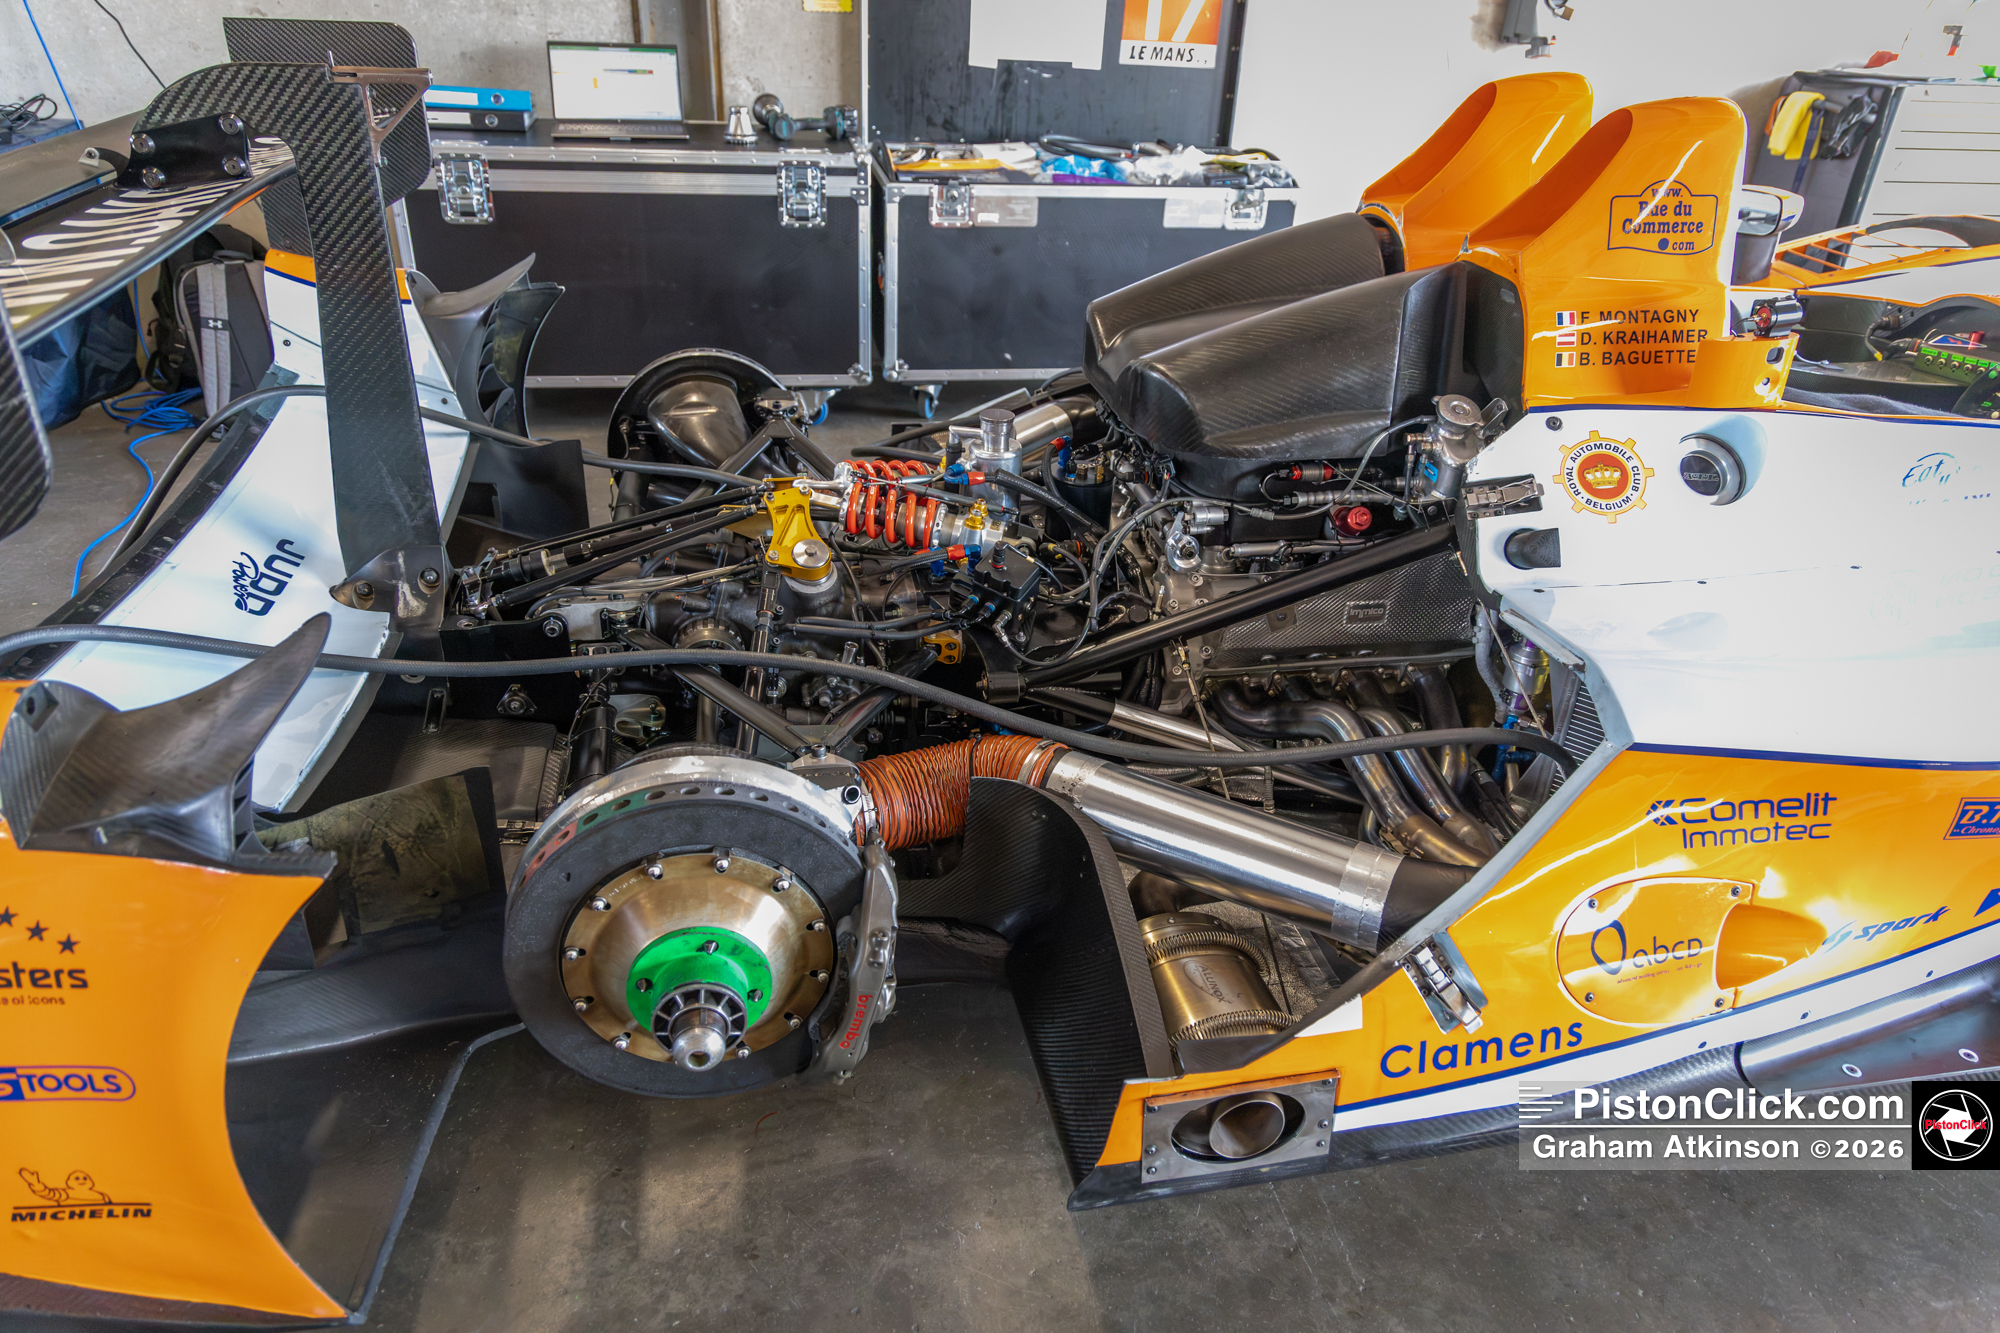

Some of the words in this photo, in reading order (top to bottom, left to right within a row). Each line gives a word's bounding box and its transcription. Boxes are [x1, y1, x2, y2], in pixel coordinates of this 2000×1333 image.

[1129, 45, 1147, 60] LE
[1673, 200, 1692, 217] du
[1622, 218, 1704, 234] Commerce
[1600, 309, 1699, 324] MONTAGNY
[1581, 331, 1597, 346] D.
[1603, 329, 1708, 345] KRAIHAMER
[1580, 352, 1596, 366] B.
[1602, 349, 1696, 366] BAGUETTE
[1570, 442, 1634, 463] AUTOMOBILE
[1566, 466, 1581, 497] ROYAL
[1631, 465, 1641, 493] CLUB
[1585, 495, 1633, 511] BELGIUM
[247, 538, 306, 617] JUDD
[1680, 792, 1837, 824] Comelit
[1682, 822, 1832, 849] Immotec
[1852, 906, 1951, 941] spark
[840, 994, 873, 1049] brembo
[1380, 1022, 1583, 1078] Clamens
[11, 1207, 152, 1222] MICHELIN
